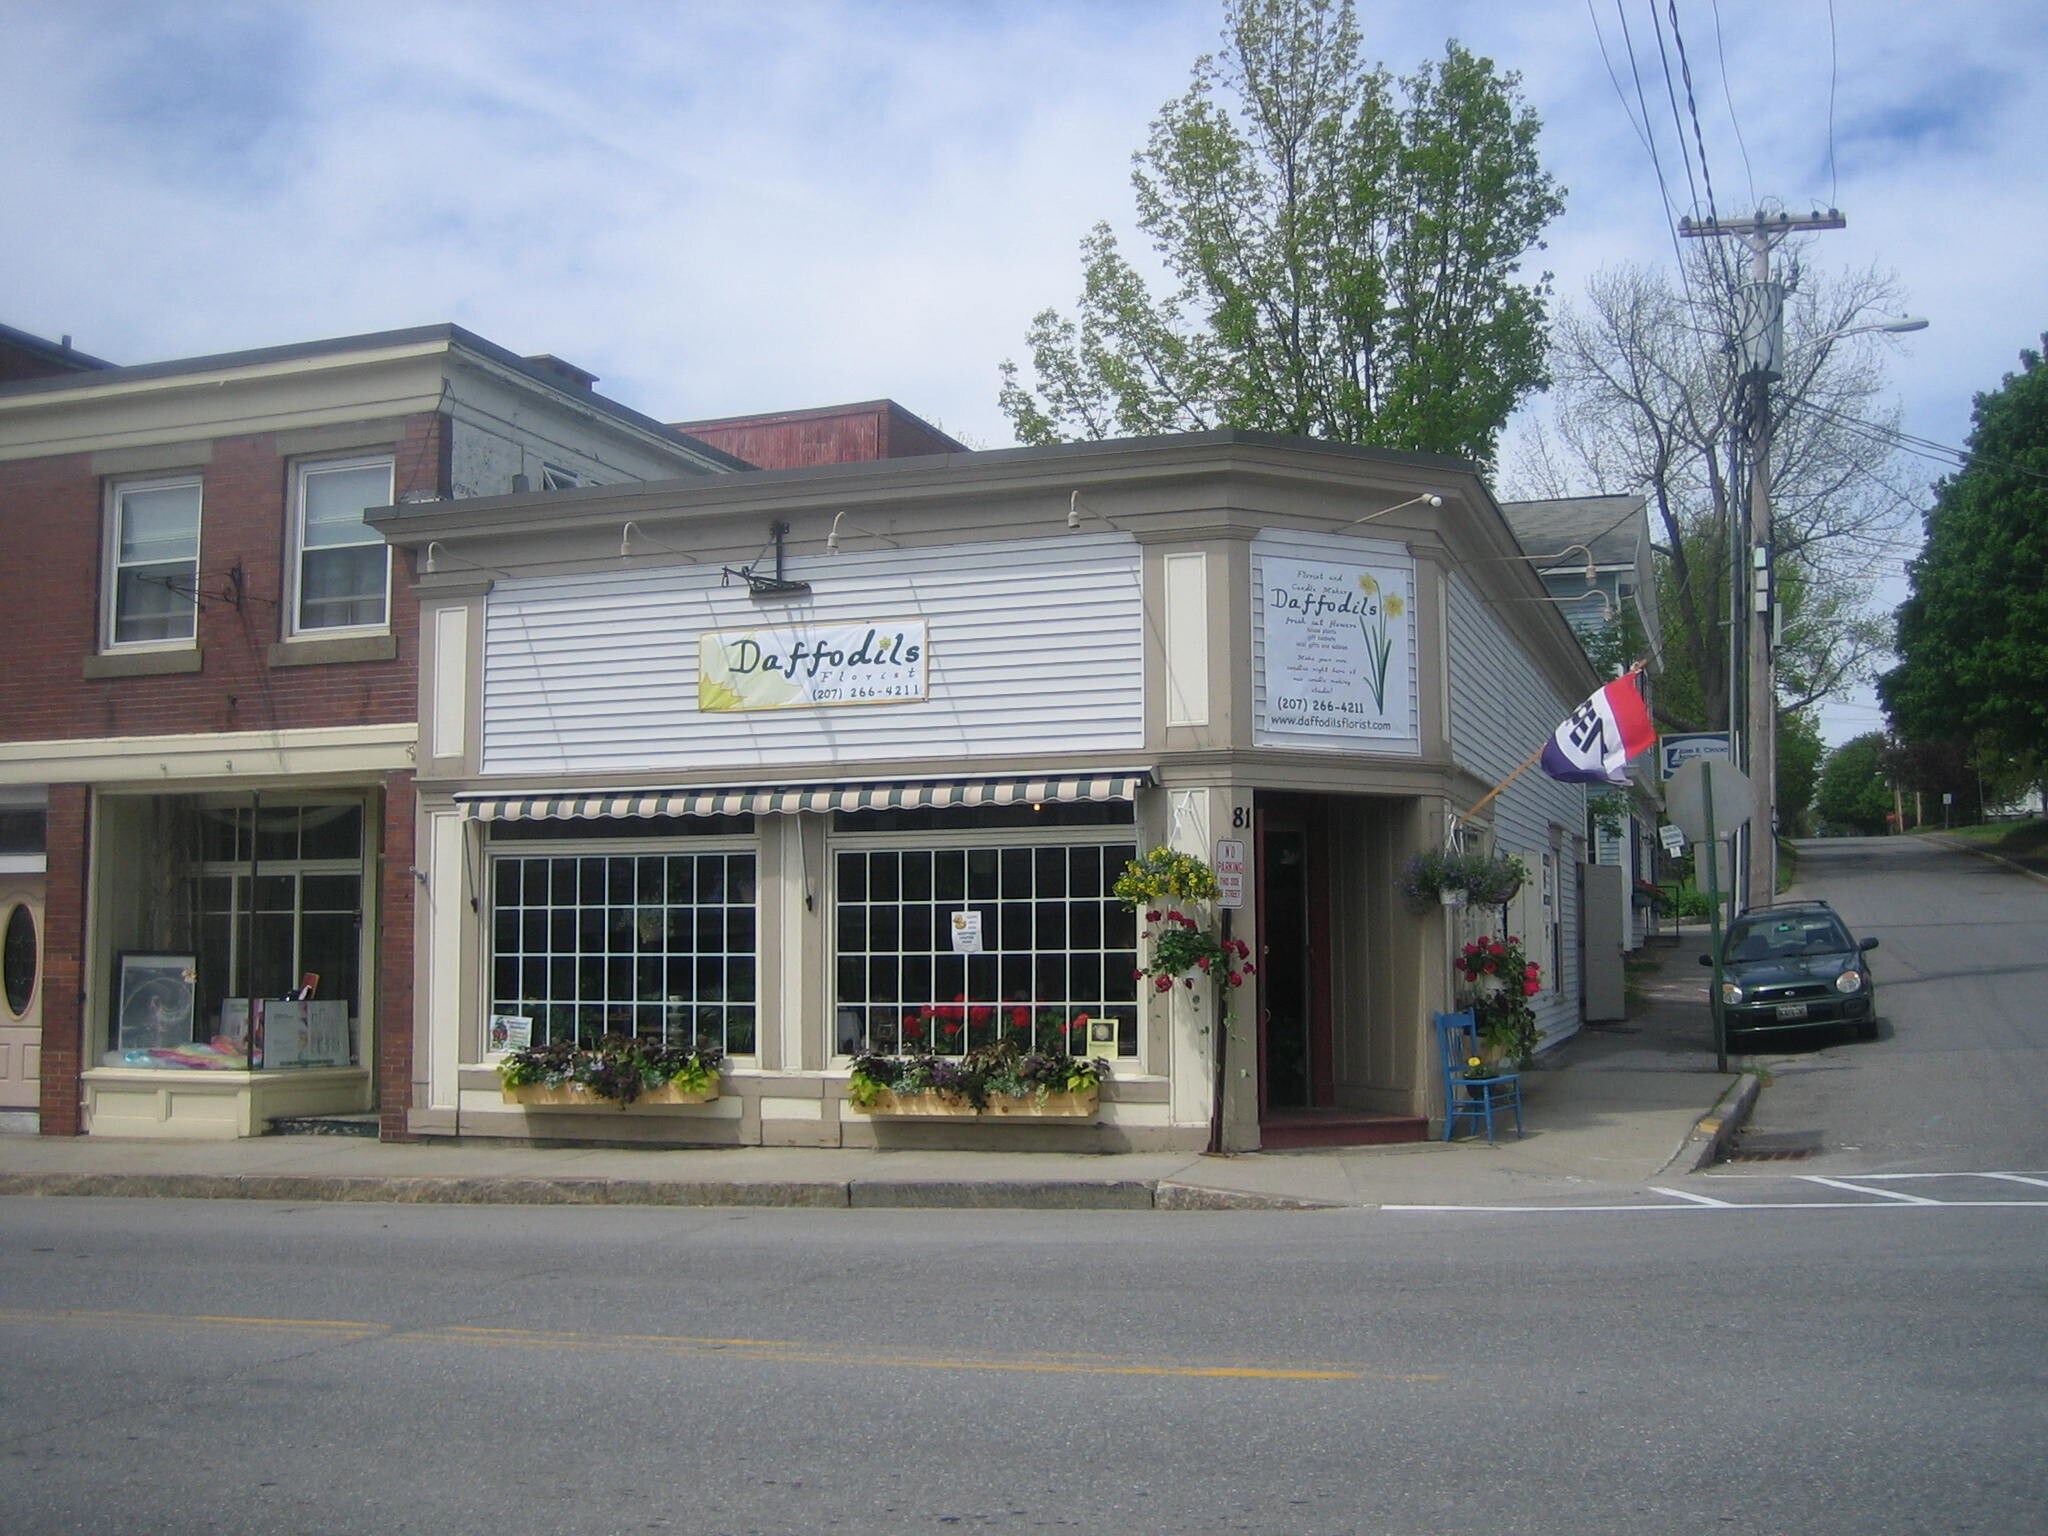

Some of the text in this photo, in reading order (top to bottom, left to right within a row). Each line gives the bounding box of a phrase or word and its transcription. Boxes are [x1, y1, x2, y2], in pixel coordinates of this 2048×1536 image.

[1270, 588, 1378, 617] Daffodils
[728, 629, 921, 679] Daffodils
[820, 668, 916, 683] Florist
[813, 685, 919, 700] (207) 266-4211
[1277, 696, 1364, 714] (207) 266-4211
[1271, 716, 1392, 731] www.daffodilsflorist.com
[1232, 806, 1251, 829] 81
